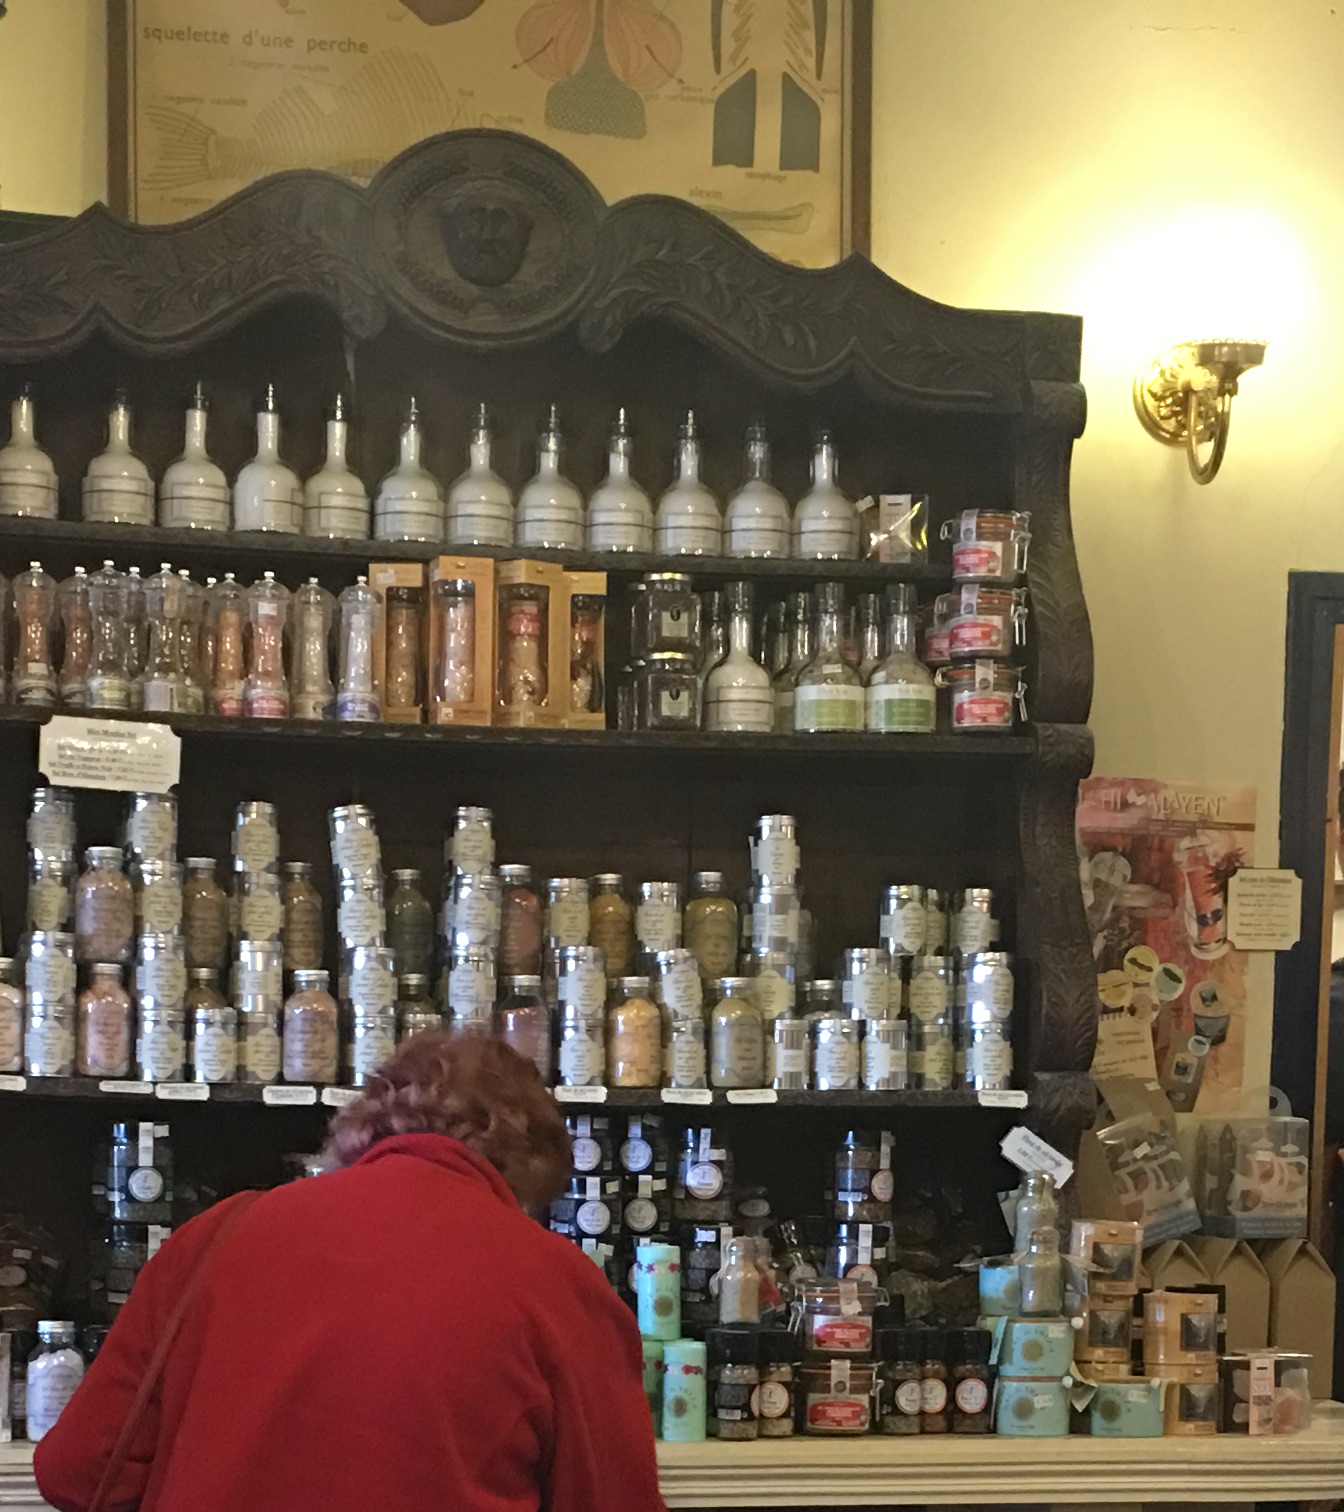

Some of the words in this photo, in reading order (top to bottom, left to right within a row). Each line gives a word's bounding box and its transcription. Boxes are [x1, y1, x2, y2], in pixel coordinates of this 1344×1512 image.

[142, 25, 230, 45] squelette
[242, 29, 295, 49] d'une
[306, 37, 370, 54] perche
